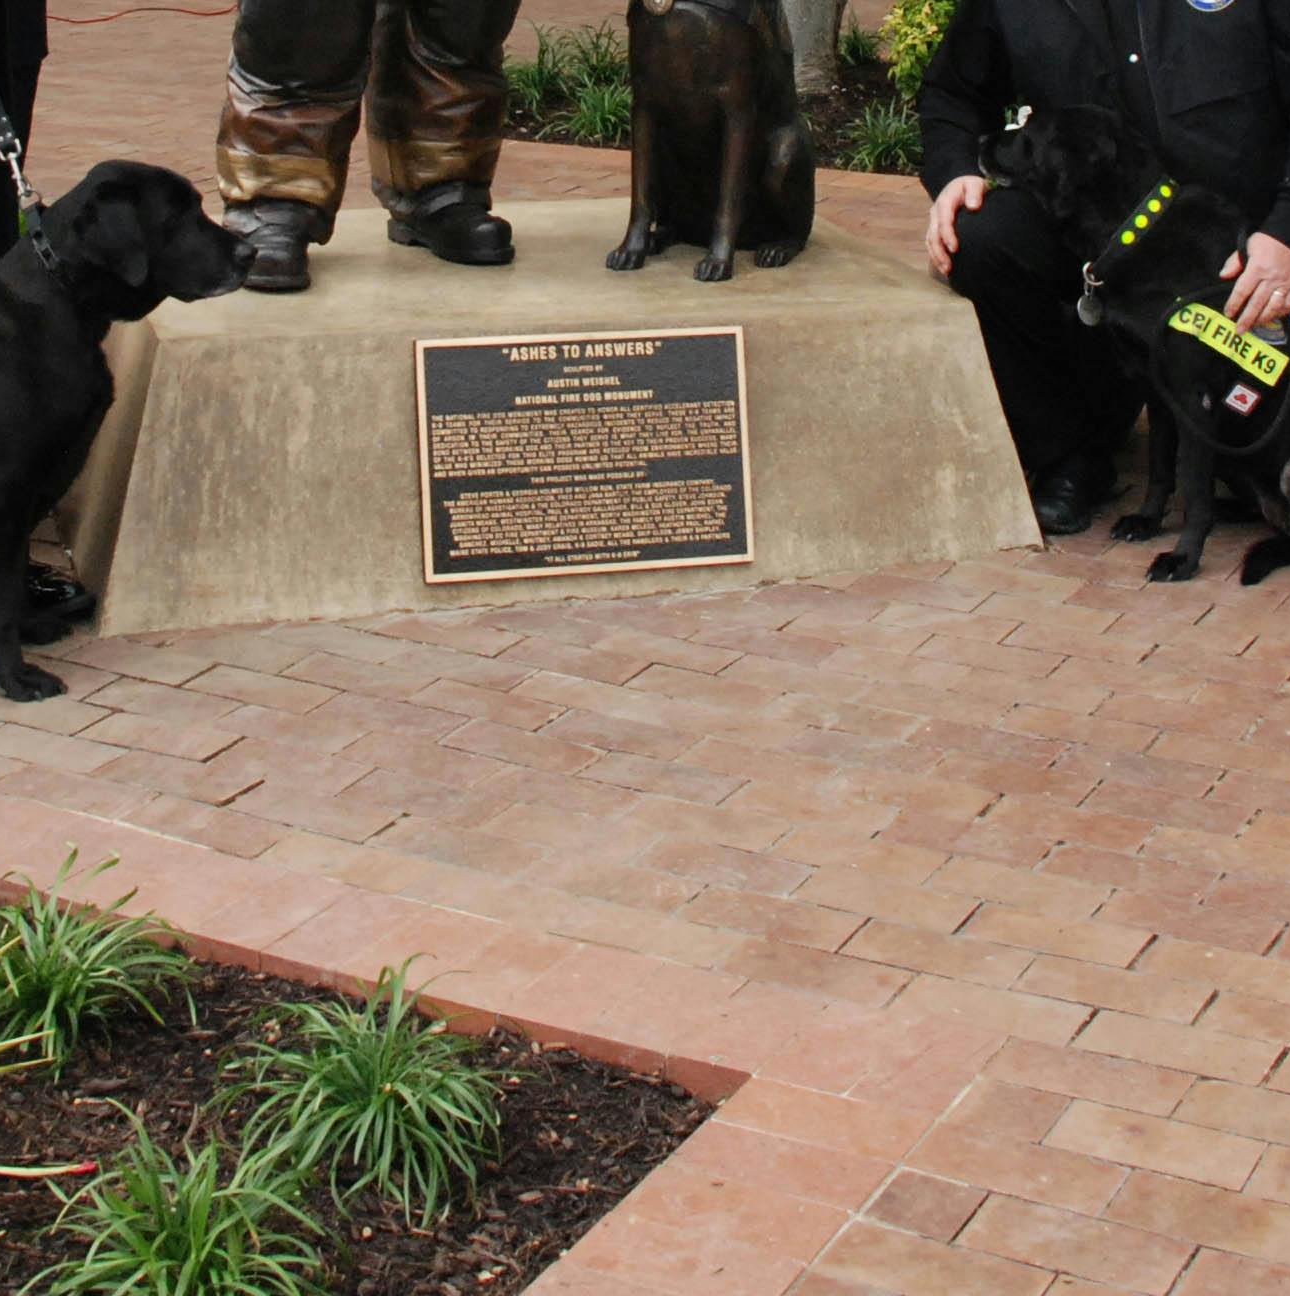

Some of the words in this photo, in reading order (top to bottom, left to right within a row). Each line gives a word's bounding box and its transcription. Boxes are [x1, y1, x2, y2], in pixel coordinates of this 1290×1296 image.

[562, 345, 580, 359] TO
[1212, 324, 1252, 359] FIRE
[1251, 350, 1277, 375] K9
[547, 377, 580, 388] AUSTIN
[515, 394, 558, 405] NATIONAL
[561, 393, 580, 403] FIRE
[583, 392, 602, 402] DOG
[604, 390, 654, 401] MONUMENT
